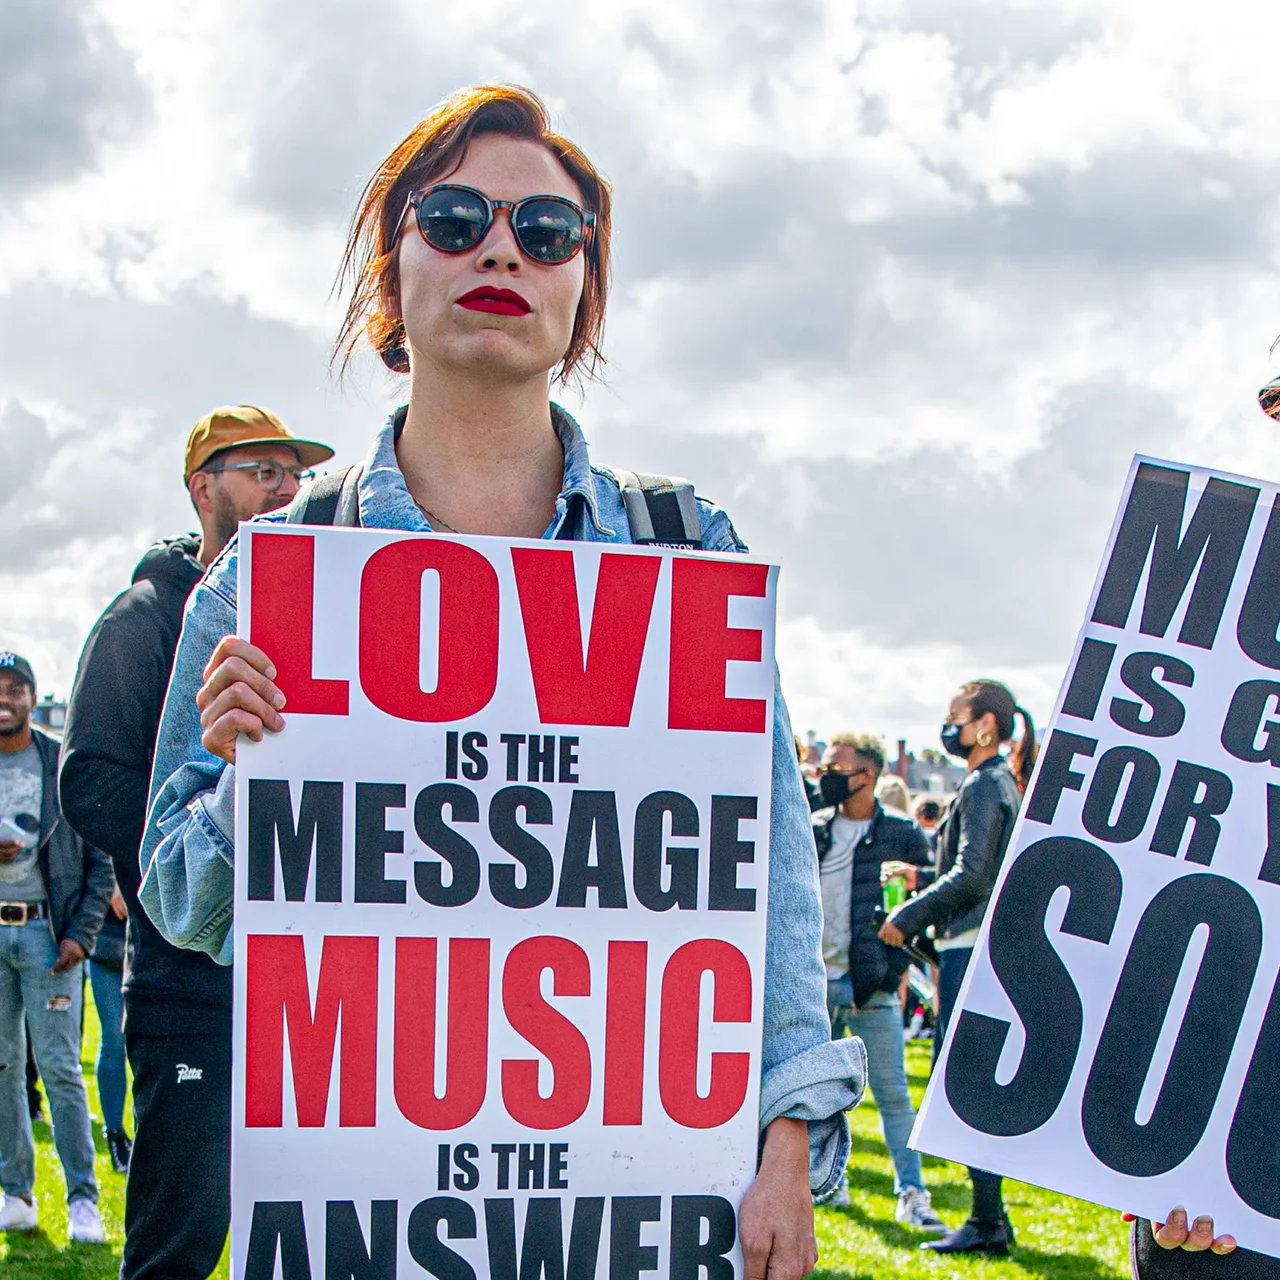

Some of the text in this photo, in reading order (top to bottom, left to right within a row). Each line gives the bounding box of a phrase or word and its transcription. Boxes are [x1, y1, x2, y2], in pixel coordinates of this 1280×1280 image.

[249, 532, 769, 734] LOVE
[1060, 636, 1195, 739] IS
[445, 731, 580, 784] IS THE
[1025, 727, 1234, 867] FOR
[247, 778, 759, 913] MESSAGE
[245, 934, 754, 1131] MUSIC
[437, 1142, 569, 1192] IS THE
